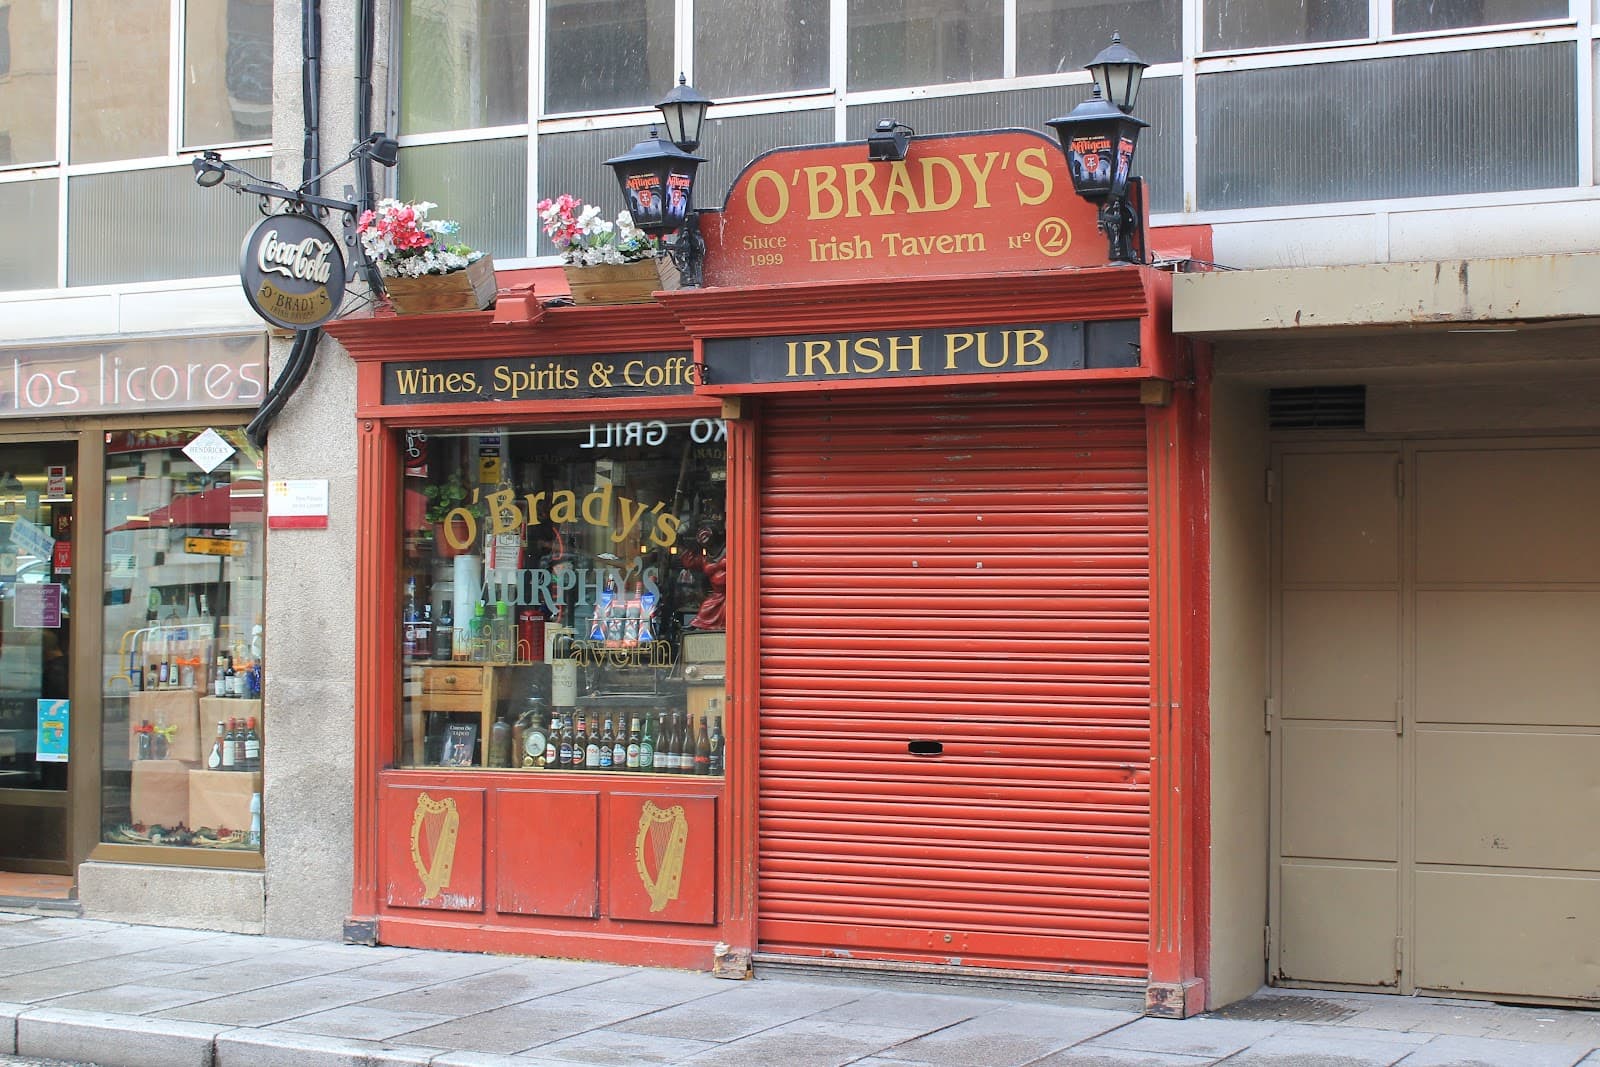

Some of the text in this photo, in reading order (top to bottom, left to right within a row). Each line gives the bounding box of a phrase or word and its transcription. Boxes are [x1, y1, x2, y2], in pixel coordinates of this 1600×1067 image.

[745, 147, 1054, 225] O'BRADY'S
[742, 234, 786, 250] Since
[749, 253, 784, 267] 1999
[808, 236, 872, 262] Irish
[881, 231, 986, 258] Tavern
[785, 329, 1049, 377] IRISH PUB
[14, 353, 262, 409] los licores
[396, 367, 483, 395] Wines,
[493, 363, 579, 398] Spirits
[588, 361, 614, 388] &
[443, 483, 681, 550] O'Brady's
[467, 557, 660, 617] MURPHY'S
